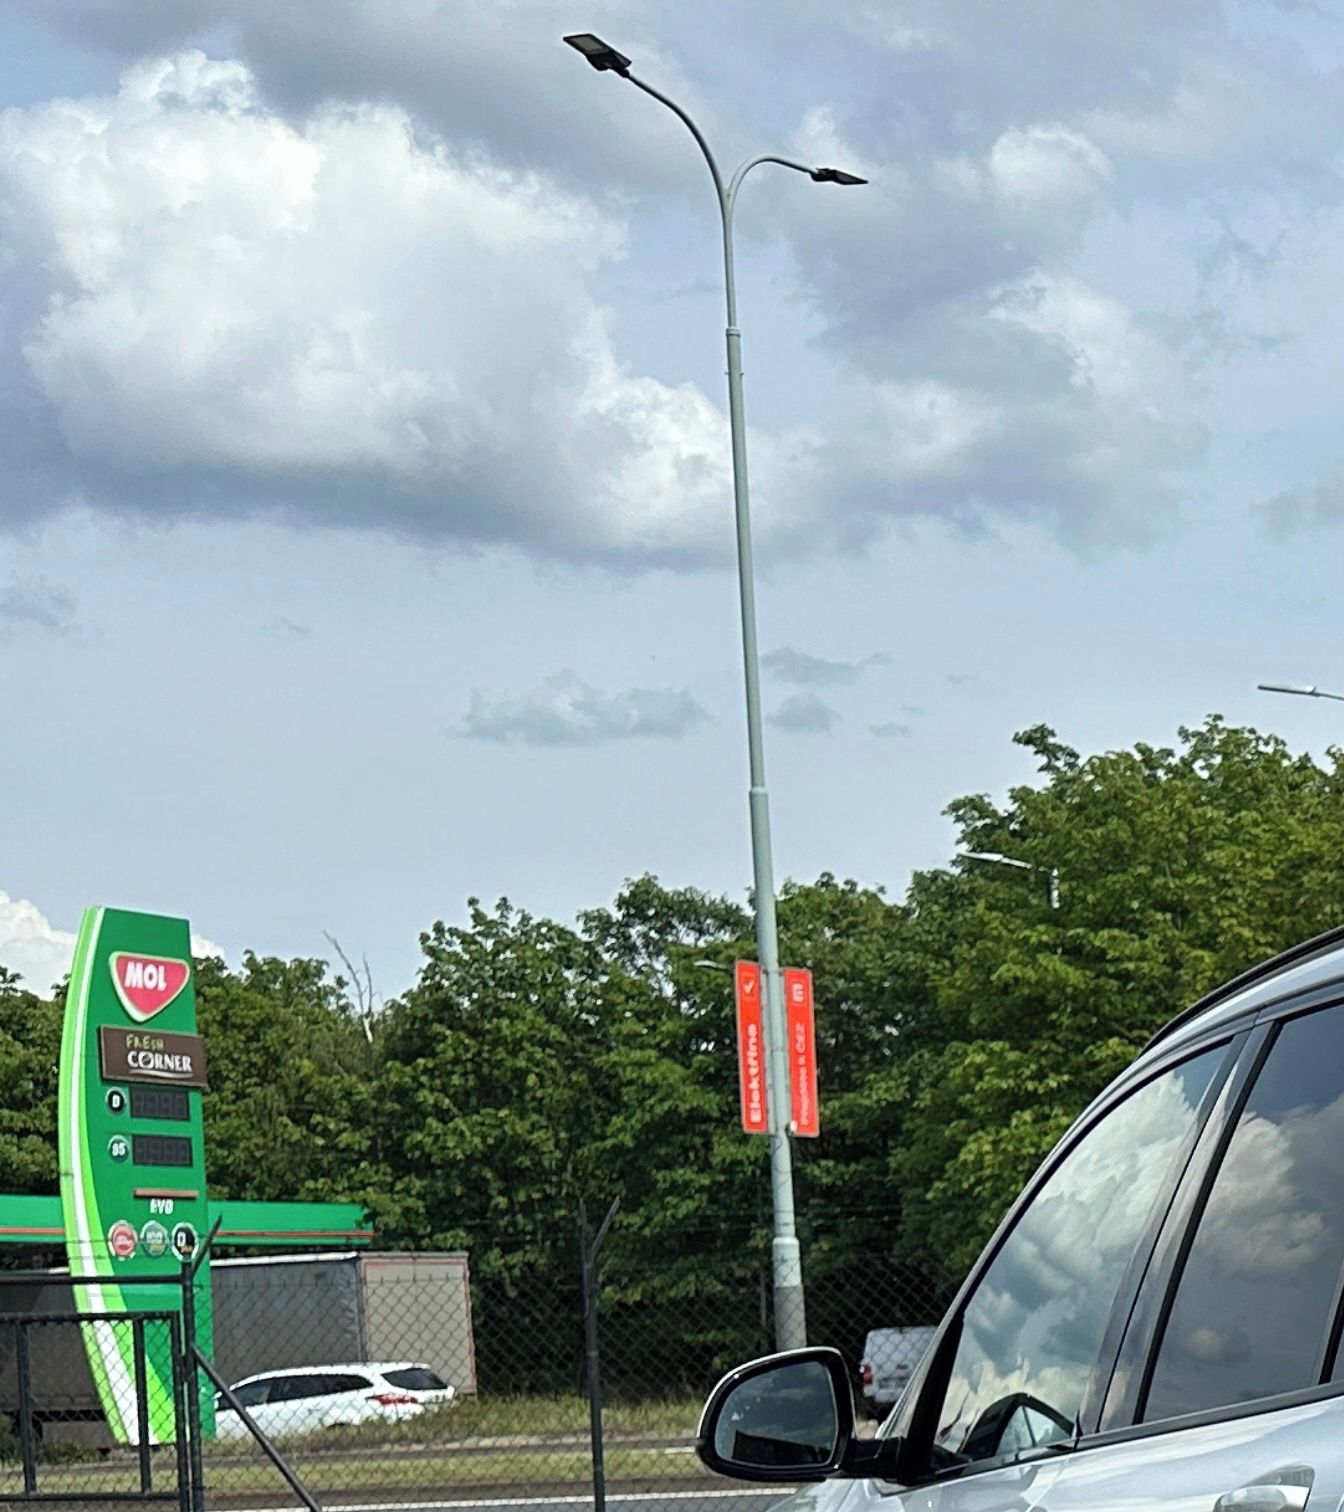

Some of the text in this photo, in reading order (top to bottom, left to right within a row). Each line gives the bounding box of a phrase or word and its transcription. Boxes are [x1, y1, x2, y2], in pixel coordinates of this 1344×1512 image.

[124, 961, 167, 992] MOL
[126, 1033, 165, 1051] FRESH
[127, 1051, 193, 1073] CORNER
